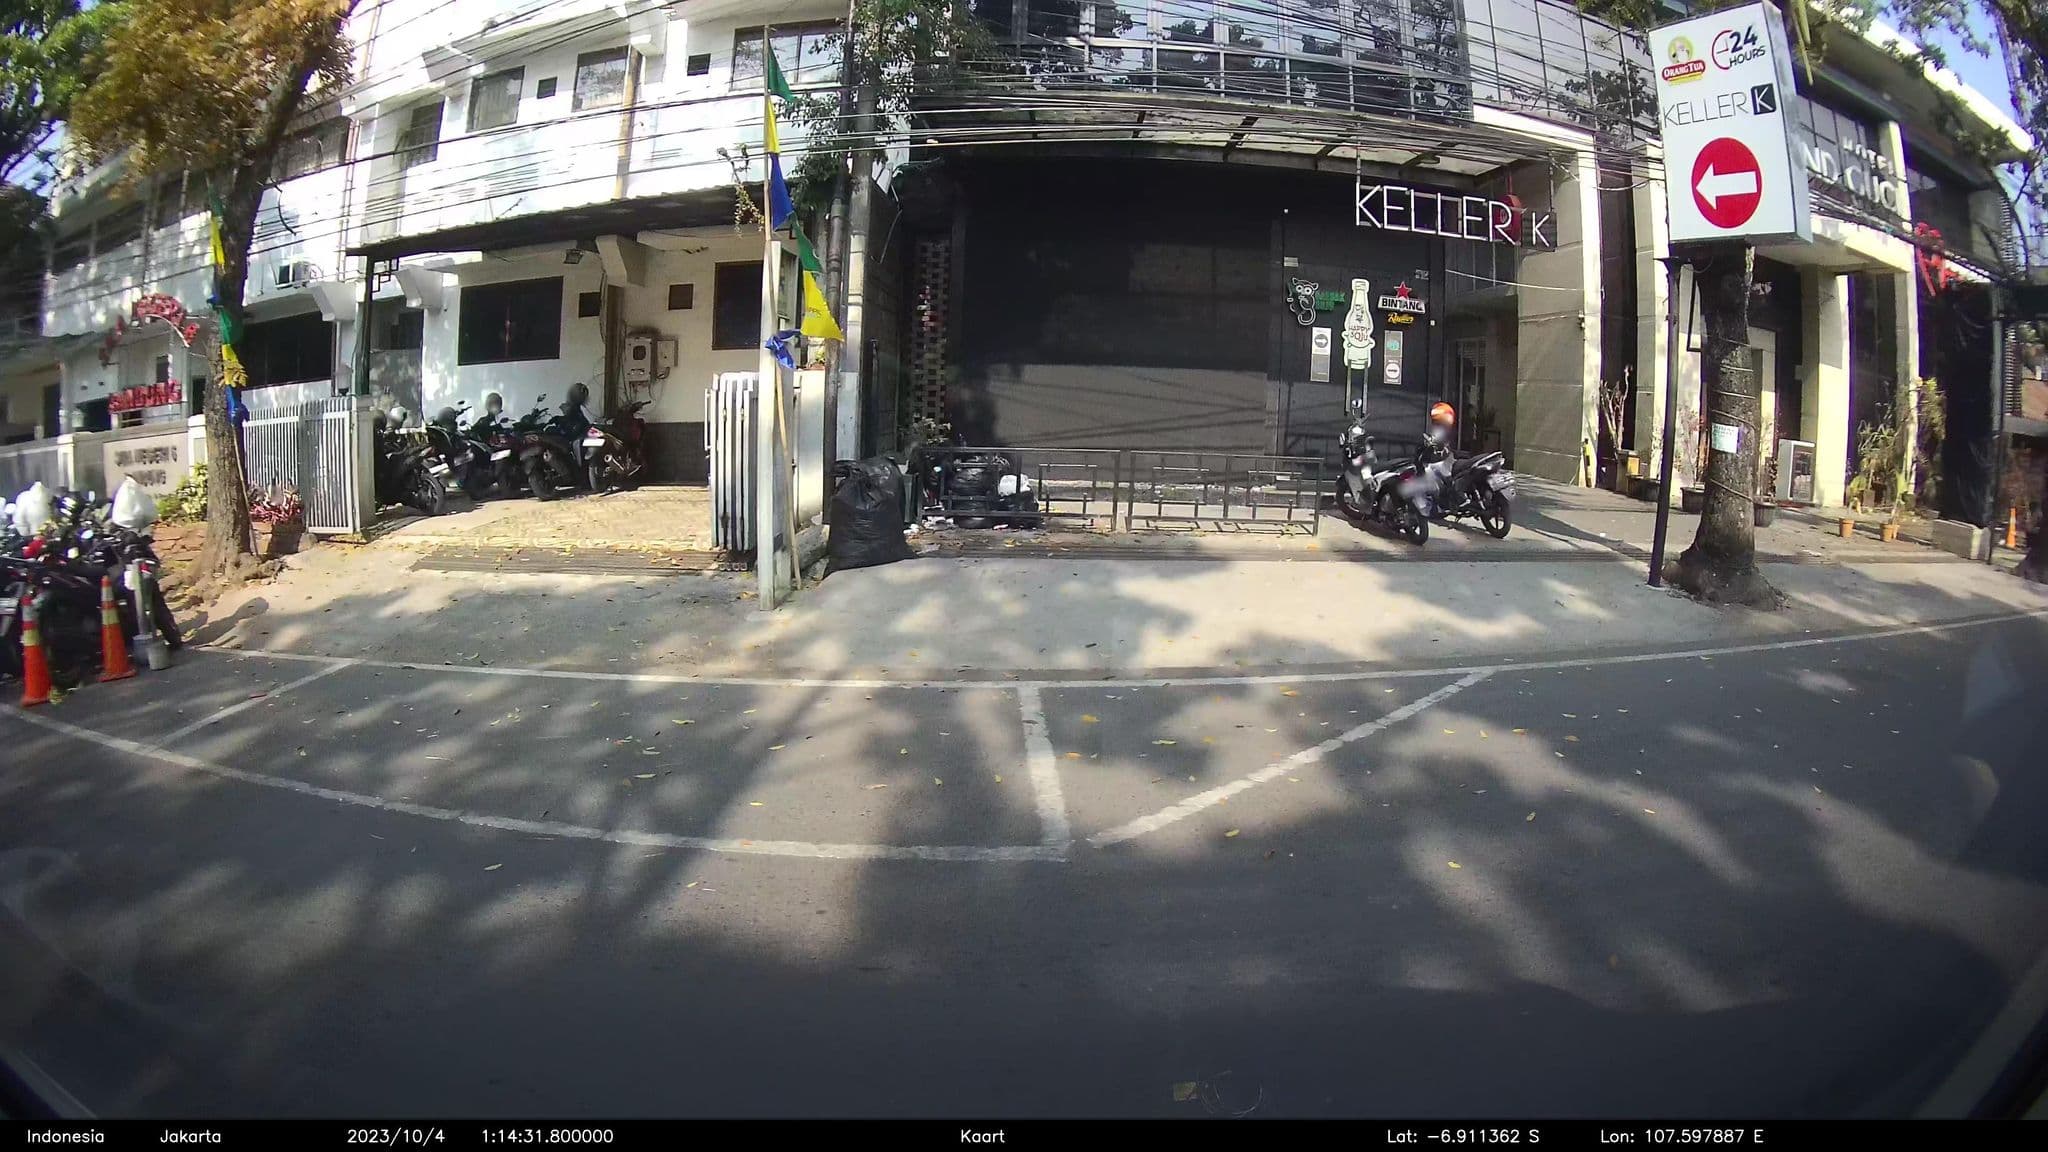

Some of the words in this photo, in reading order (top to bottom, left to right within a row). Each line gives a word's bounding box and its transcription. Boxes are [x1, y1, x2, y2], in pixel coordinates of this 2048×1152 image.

[1729, 25, 1758, 53] 24
[1729, 45, 1766, 67] HOURS
[1663, 91, 1749, 128] KELLER
[1754, 85, 1774, 114] K
[1355, 182, 1517, 246] KELLER
[1532, 212, 1550, 247] K
